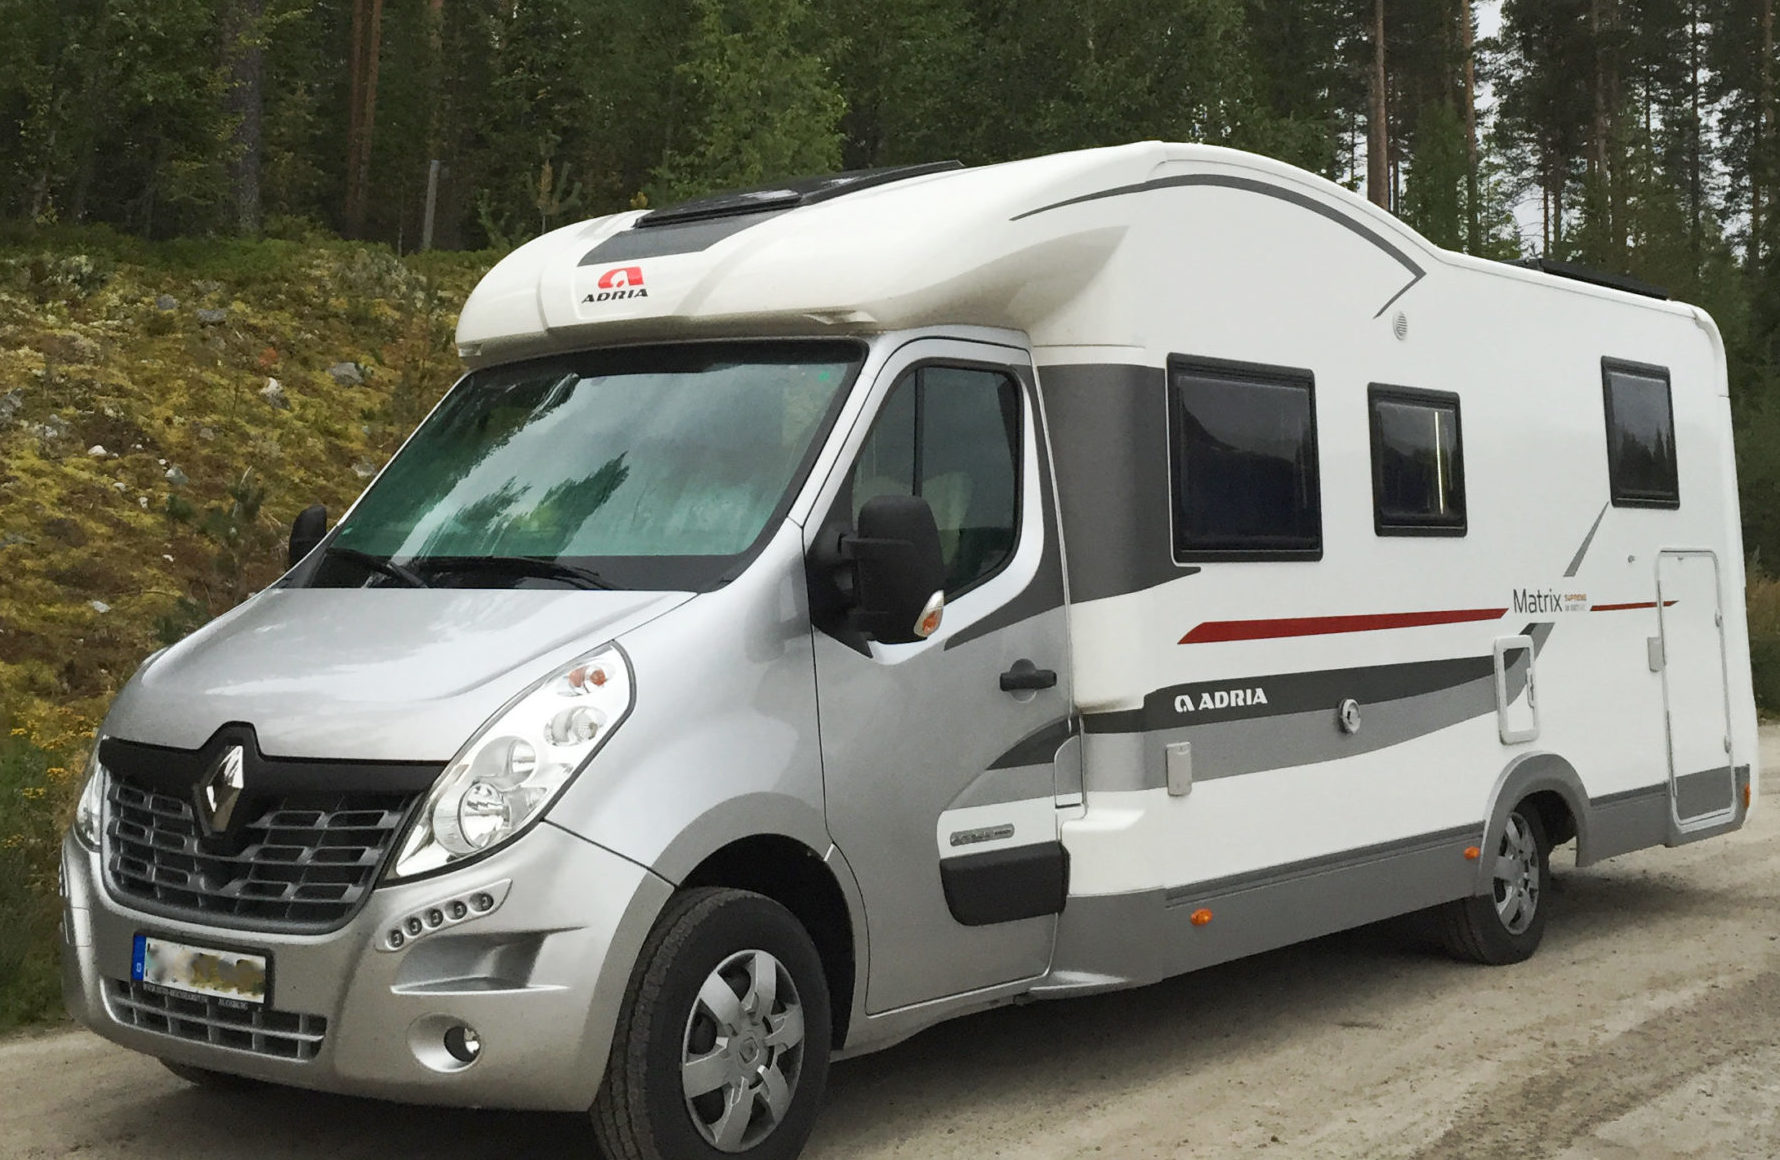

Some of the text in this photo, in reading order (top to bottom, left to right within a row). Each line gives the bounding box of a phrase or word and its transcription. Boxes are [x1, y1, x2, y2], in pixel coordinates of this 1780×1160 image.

[581, 288, 649, 304] ADRIA
[1513, 587, 1563, 614] Matrix
[1198, 687, 1269, 711] ADRIA
